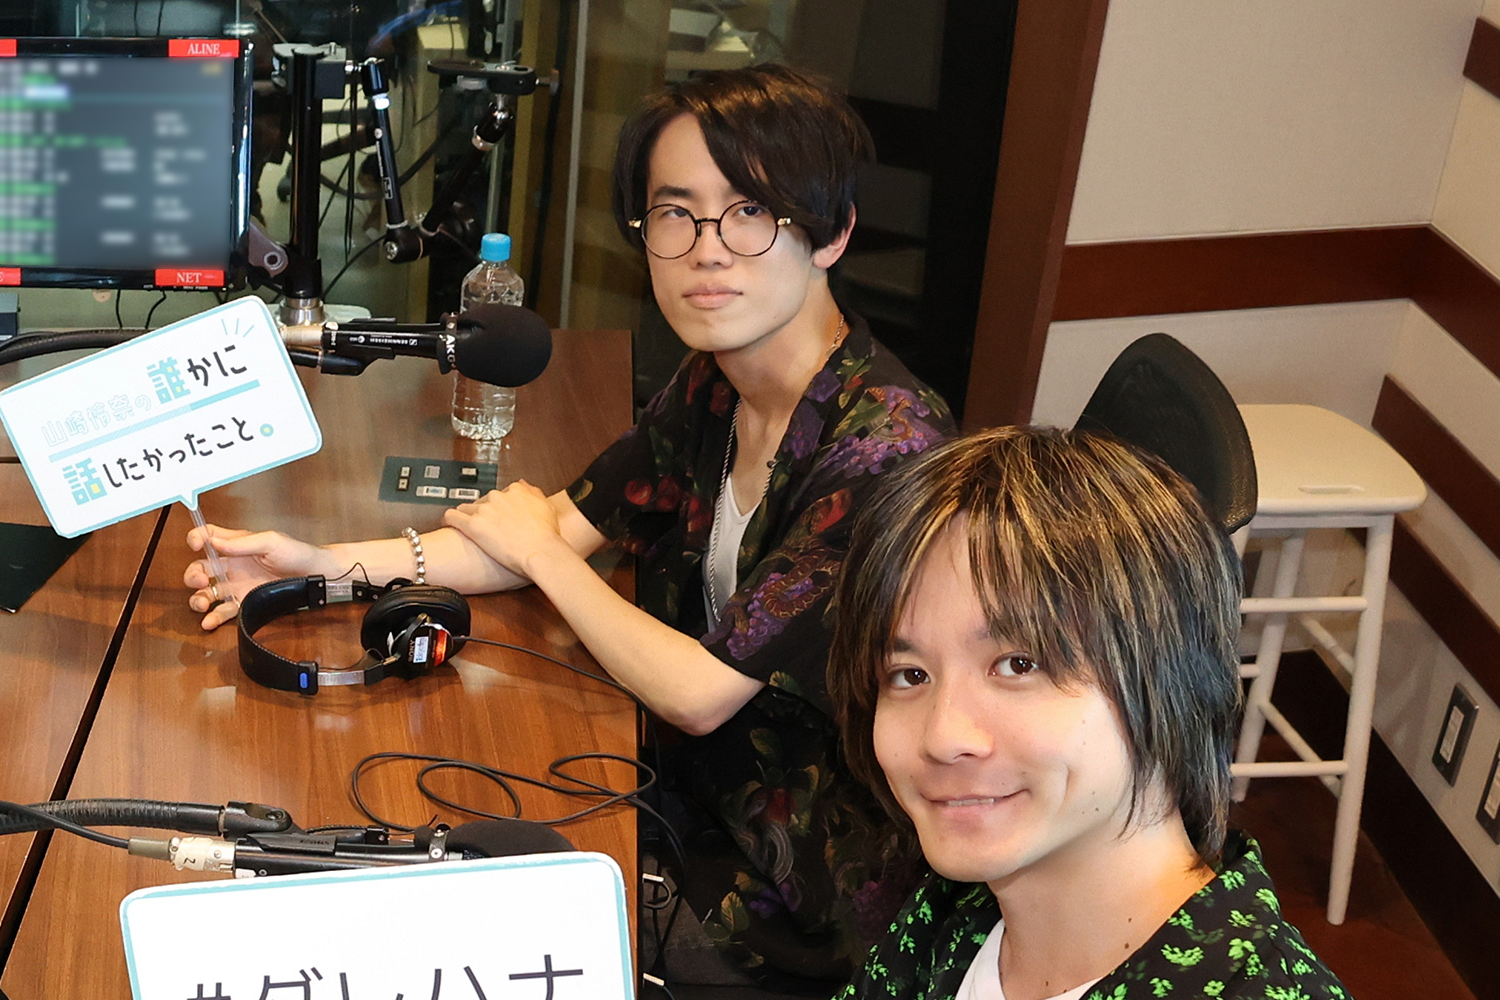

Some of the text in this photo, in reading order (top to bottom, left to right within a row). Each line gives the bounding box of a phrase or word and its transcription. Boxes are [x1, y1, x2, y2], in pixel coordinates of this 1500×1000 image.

[187, 43, 220, 55] ALINE
[177, 272, 202, 283] NET
[445, 334, 456, 363] AKG
[62, 416, 274, 505] 話したかったこと。
